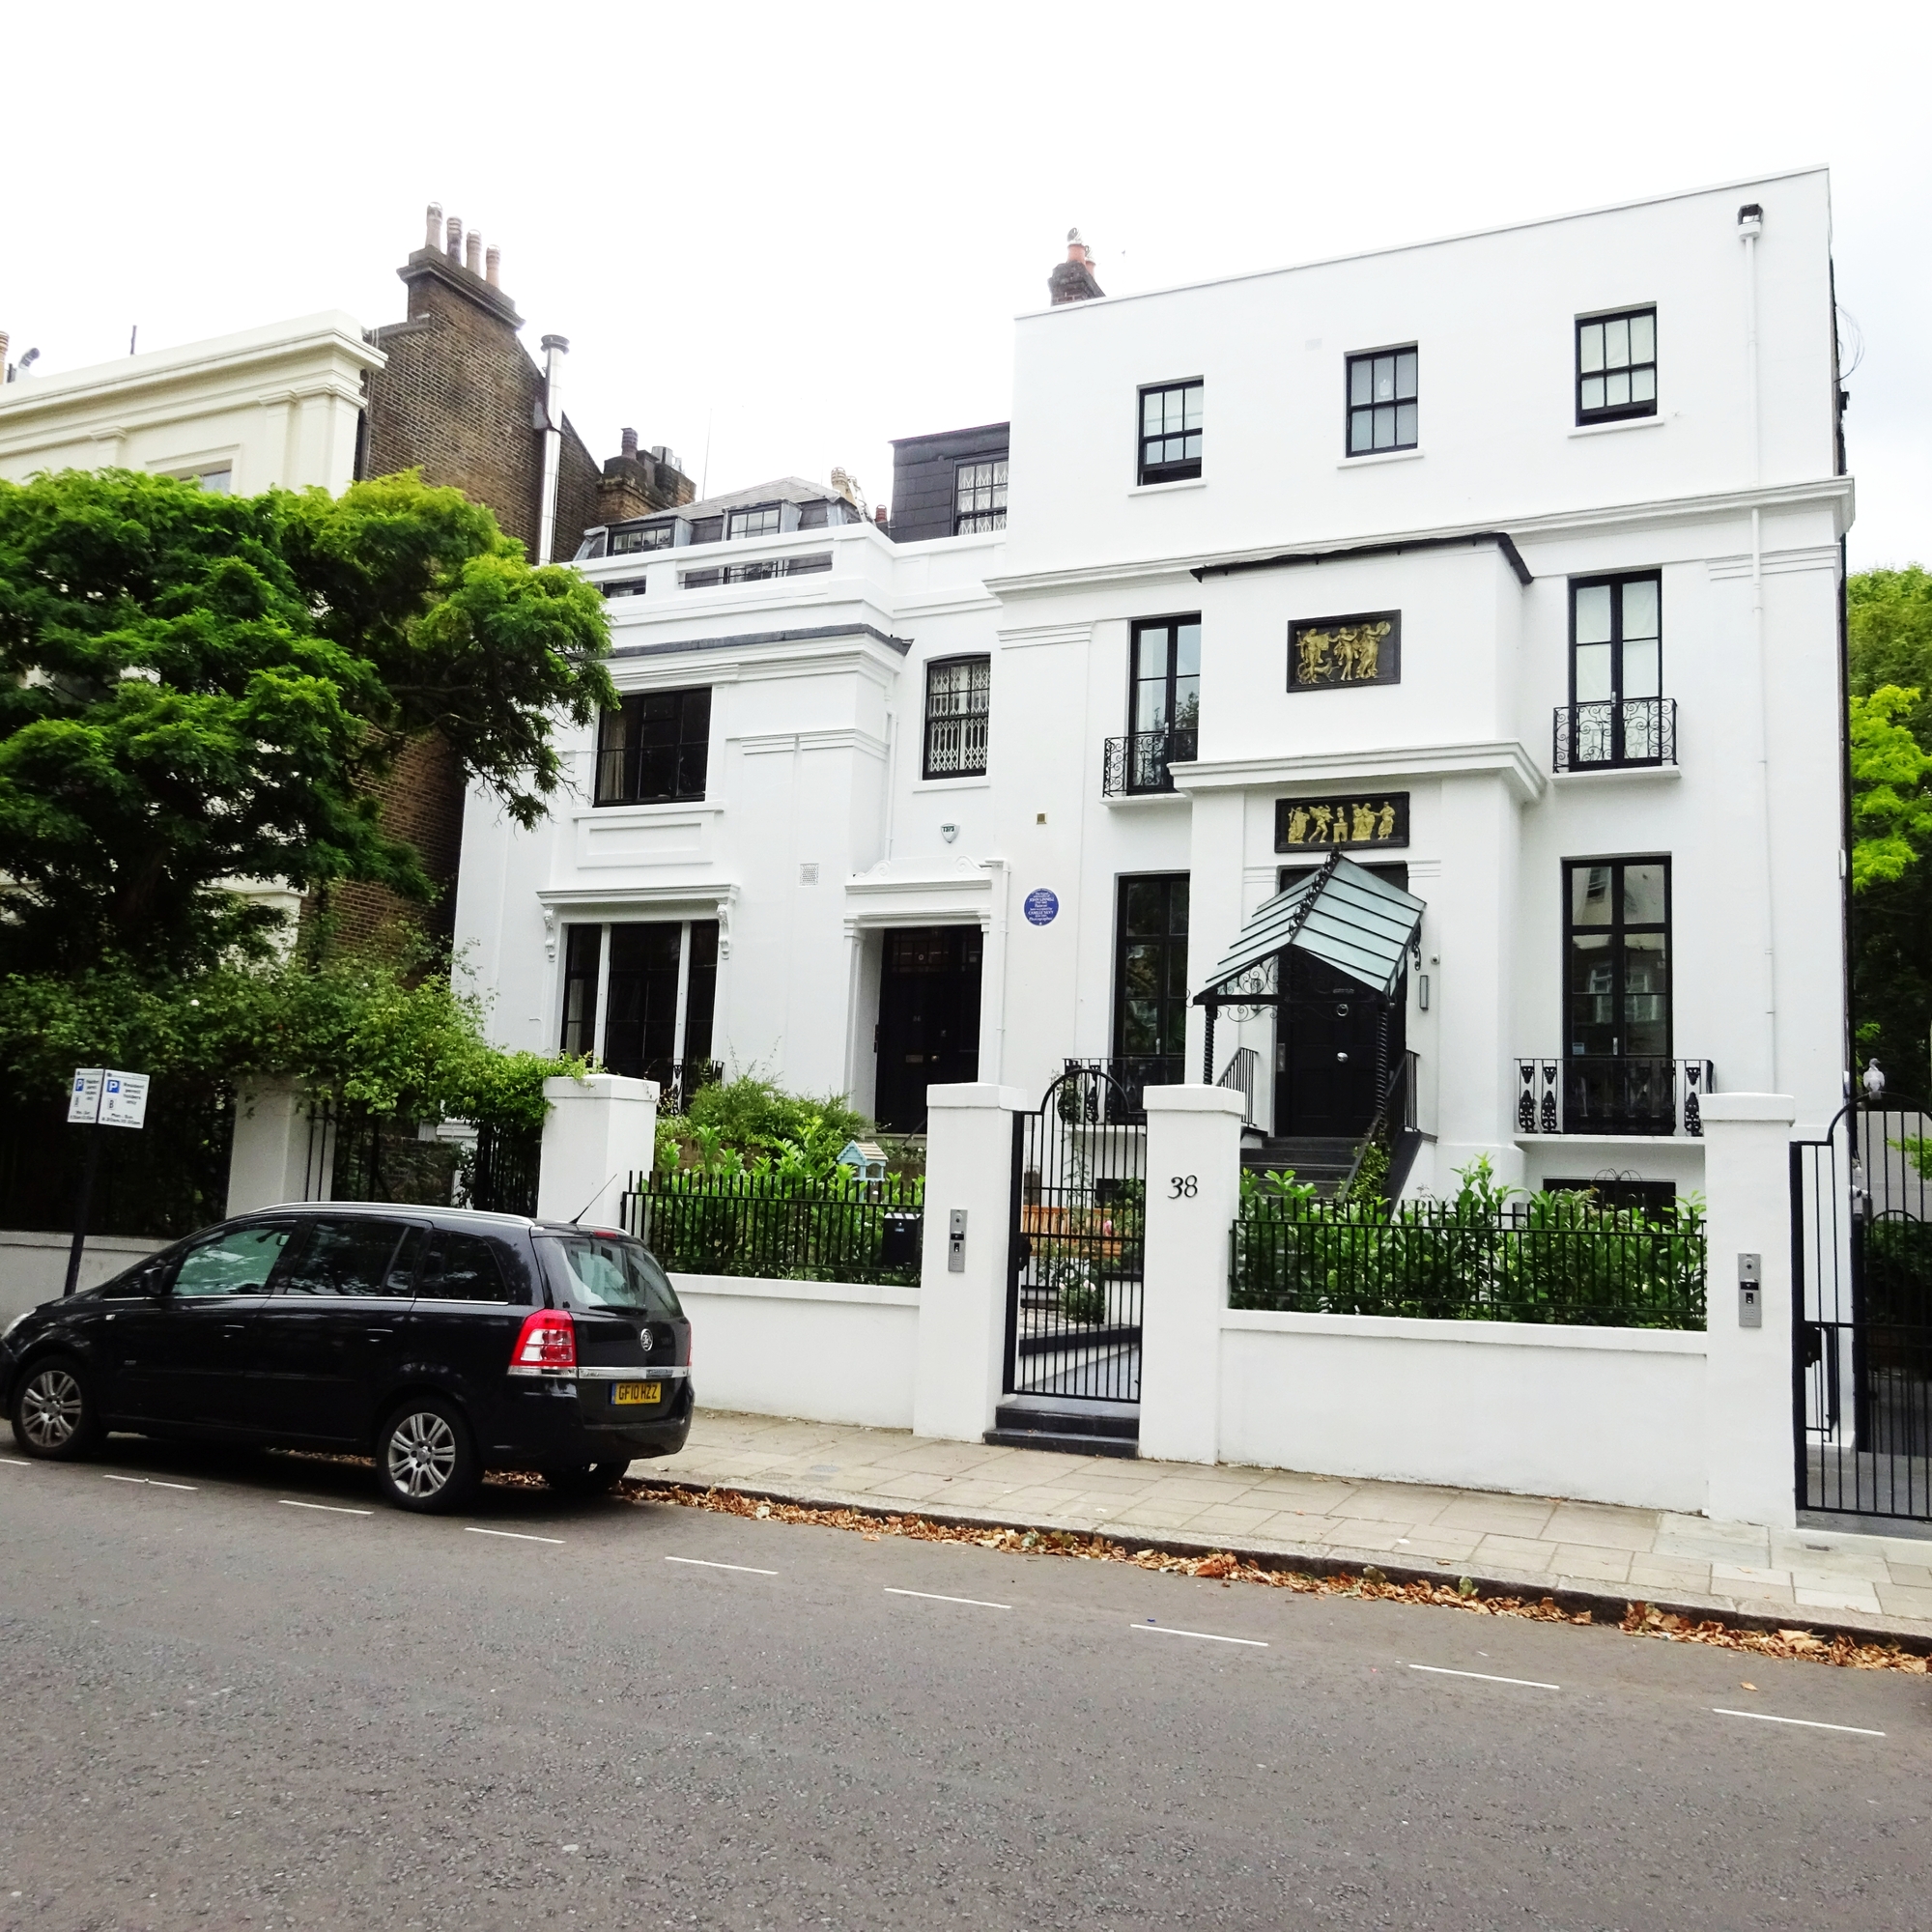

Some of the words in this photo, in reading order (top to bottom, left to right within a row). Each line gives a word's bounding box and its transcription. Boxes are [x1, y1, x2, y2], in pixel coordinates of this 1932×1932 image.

[1167, 1175, 1198, 1199] 38
[618, 1384, 639, 1401] GF10
[640, 1384, 657, 1400] HZZ
